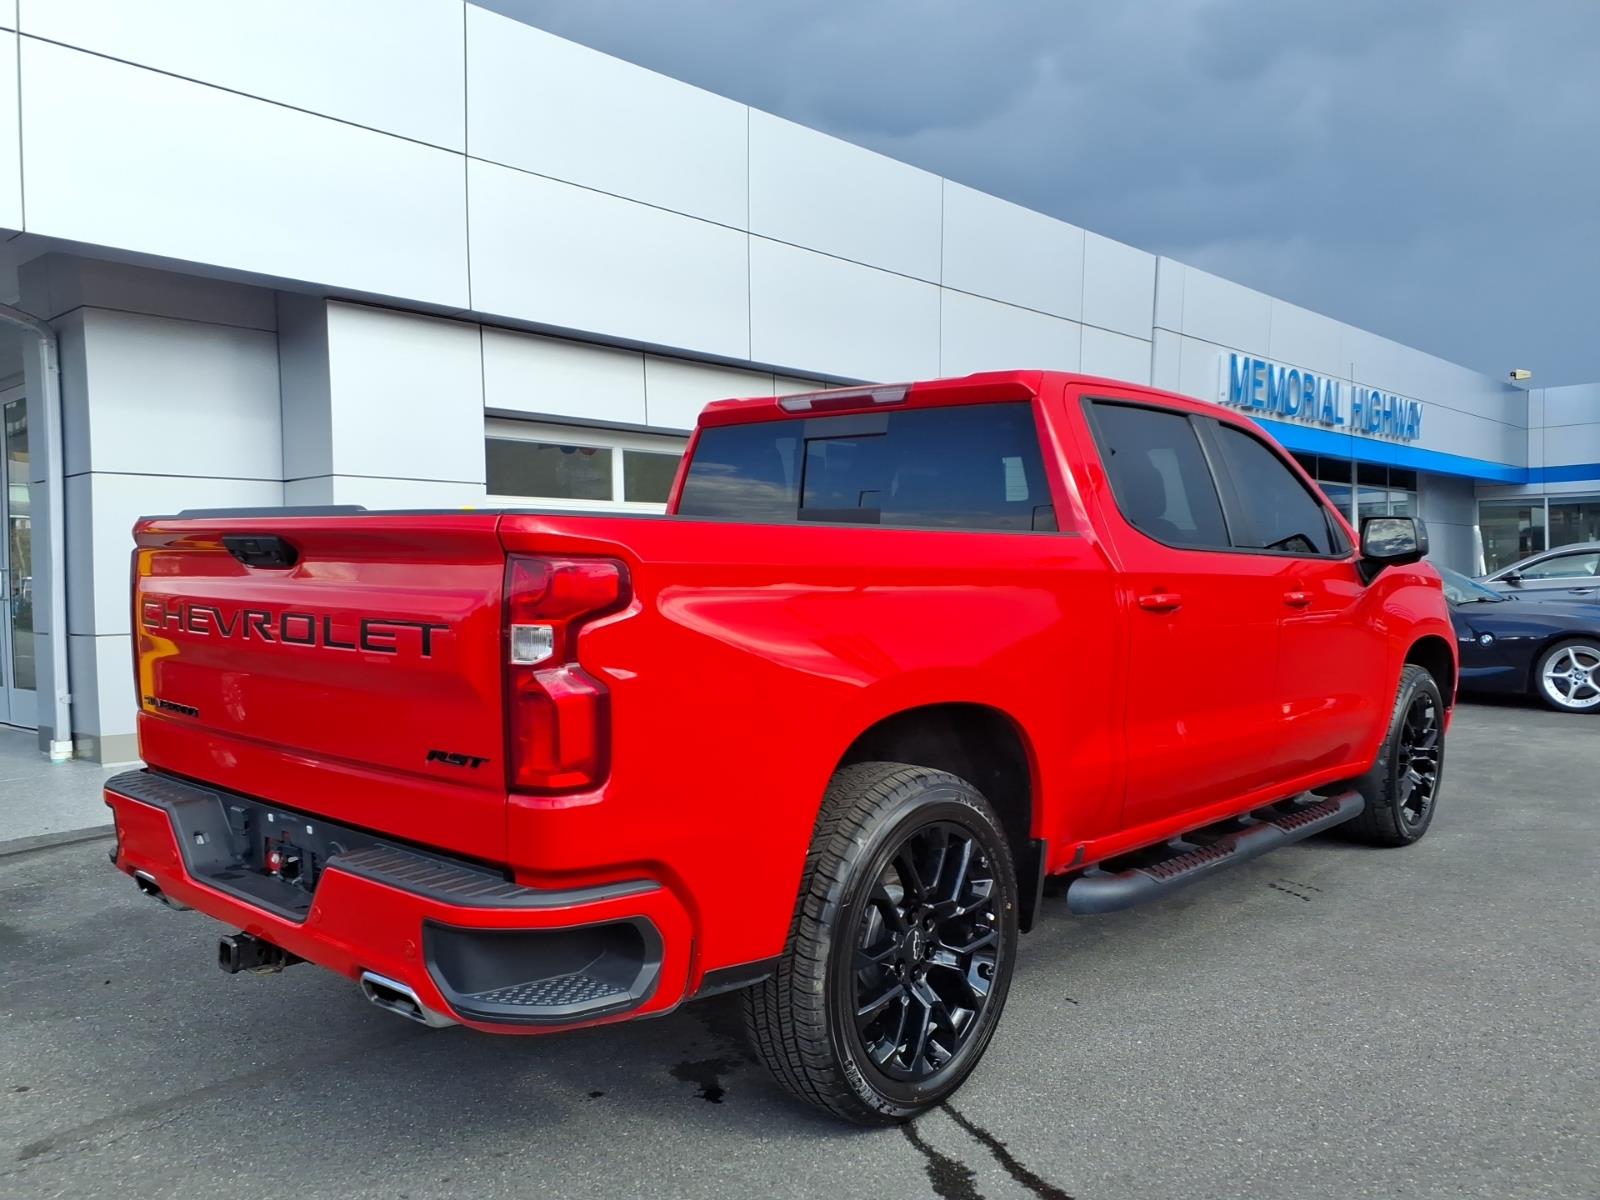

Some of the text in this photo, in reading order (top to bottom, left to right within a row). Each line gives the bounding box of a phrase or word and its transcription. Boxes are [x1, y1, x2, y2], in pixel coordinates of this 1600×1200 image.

[1229, 353, 1424, 440] MEMORIAL HIGHWAY
[142, 599, 450, 658] CHEVROLET
[426, 748, 491, 769] RST
